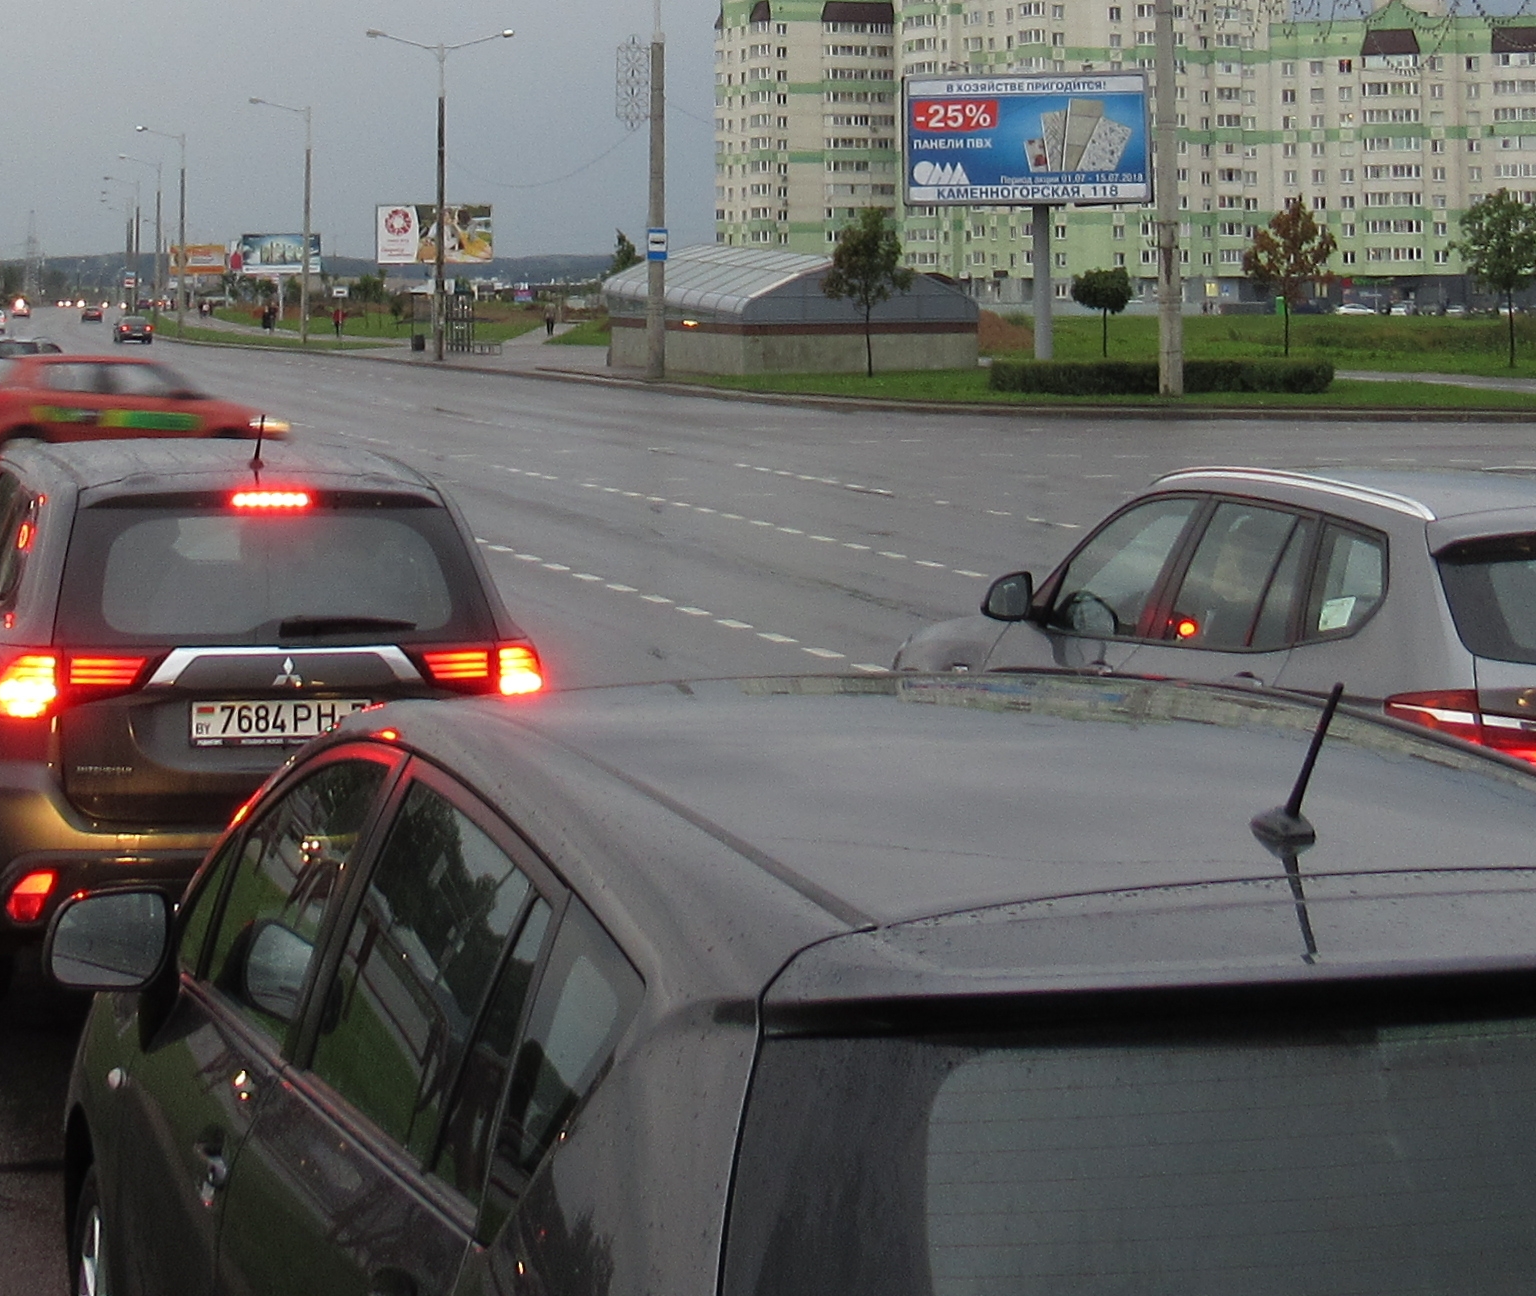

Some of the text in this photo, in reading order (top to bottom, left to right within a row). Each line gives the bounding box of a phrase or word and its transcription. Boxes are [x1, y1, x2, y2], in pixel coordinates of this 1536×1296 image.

[946, 81, 1106, 93] В ХОЗЯЙСТВЕ ПРИГОДИТСЯ!
[915, 104, 991, 128] -25%
[913, 138, 993, 150] ПАНЕЛИ ПВХ
[937, 185, 1119, 199] КАМЕННОГОРСКАЯ, 118
[220, 705, 287, 734] 7684
